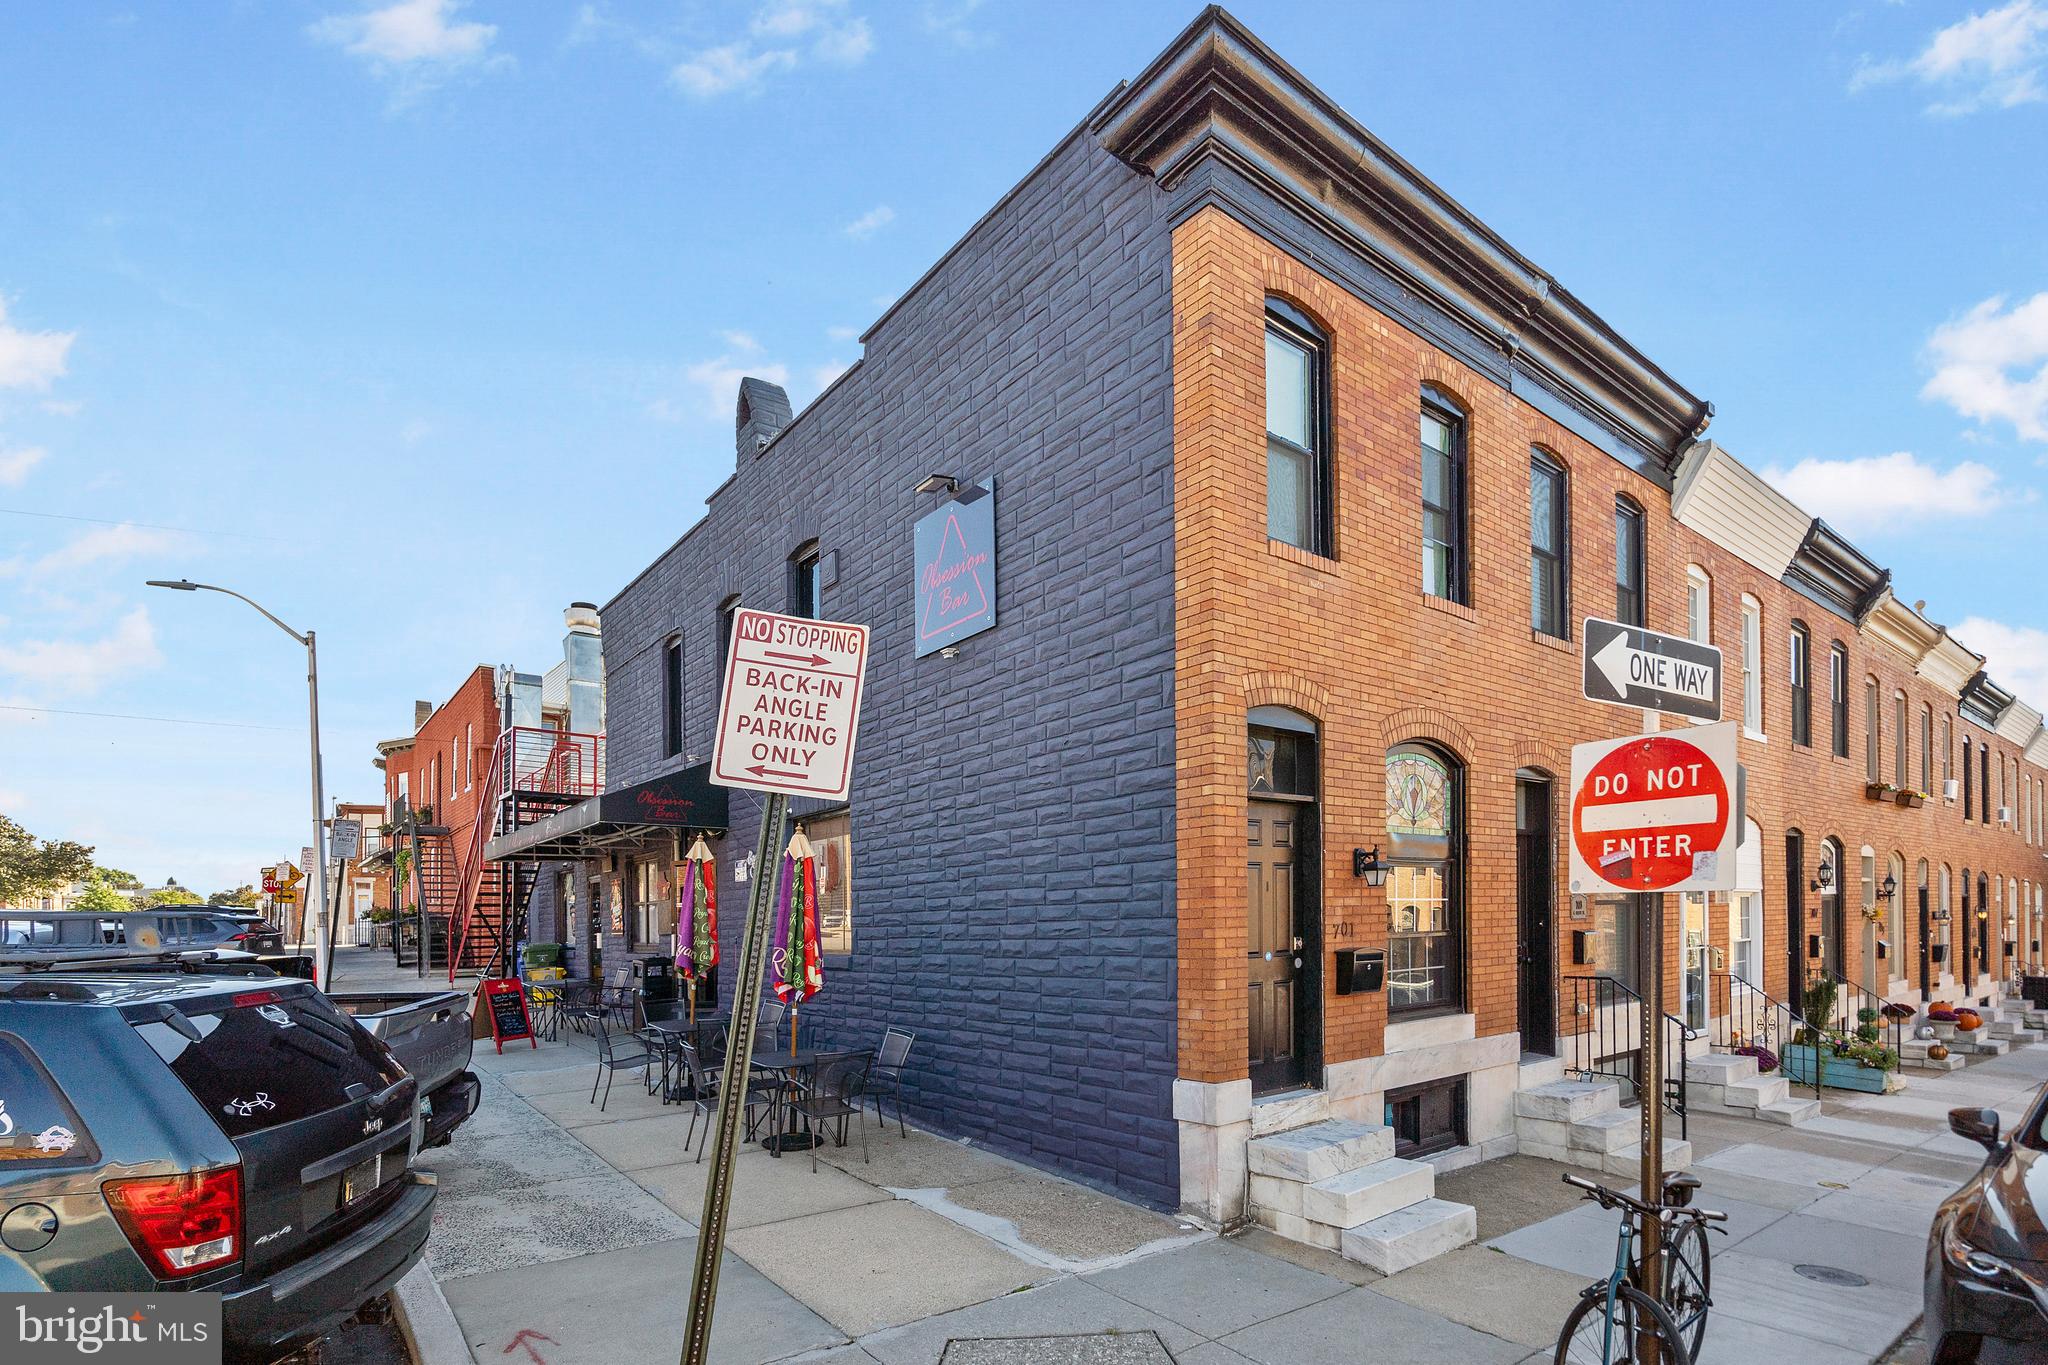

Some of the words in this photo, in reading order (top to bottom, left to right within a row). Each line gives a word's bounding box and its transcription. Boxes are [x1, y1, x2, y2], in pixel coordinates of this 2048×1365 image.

[920, 551, 988, 596] Obsession
[939, 586, 970, 616] Bar
[741, 615, 771, 641] NO
[775, 622, 858, 655] STOPPING
[745, 667, 843, 699] BACK-IN
[1630, 653, 1667, 687] ONE
[1674, 662, 1708, 696] WAY
[753, 694, 828, 722] ANGLE
[736, 714, 837, 746] PARKING
[751, 742, 817, 767] ONLY
[1594, 772, 1629, 797] DO
[1646, 763, 1703, 792] NOT
[1603, 833, 1692, 859] ENTER
[263, 879, 282, 888] STO
[1332, 921, 1354, 939] 701
[362, 1117, 383, 1135] Jeep
